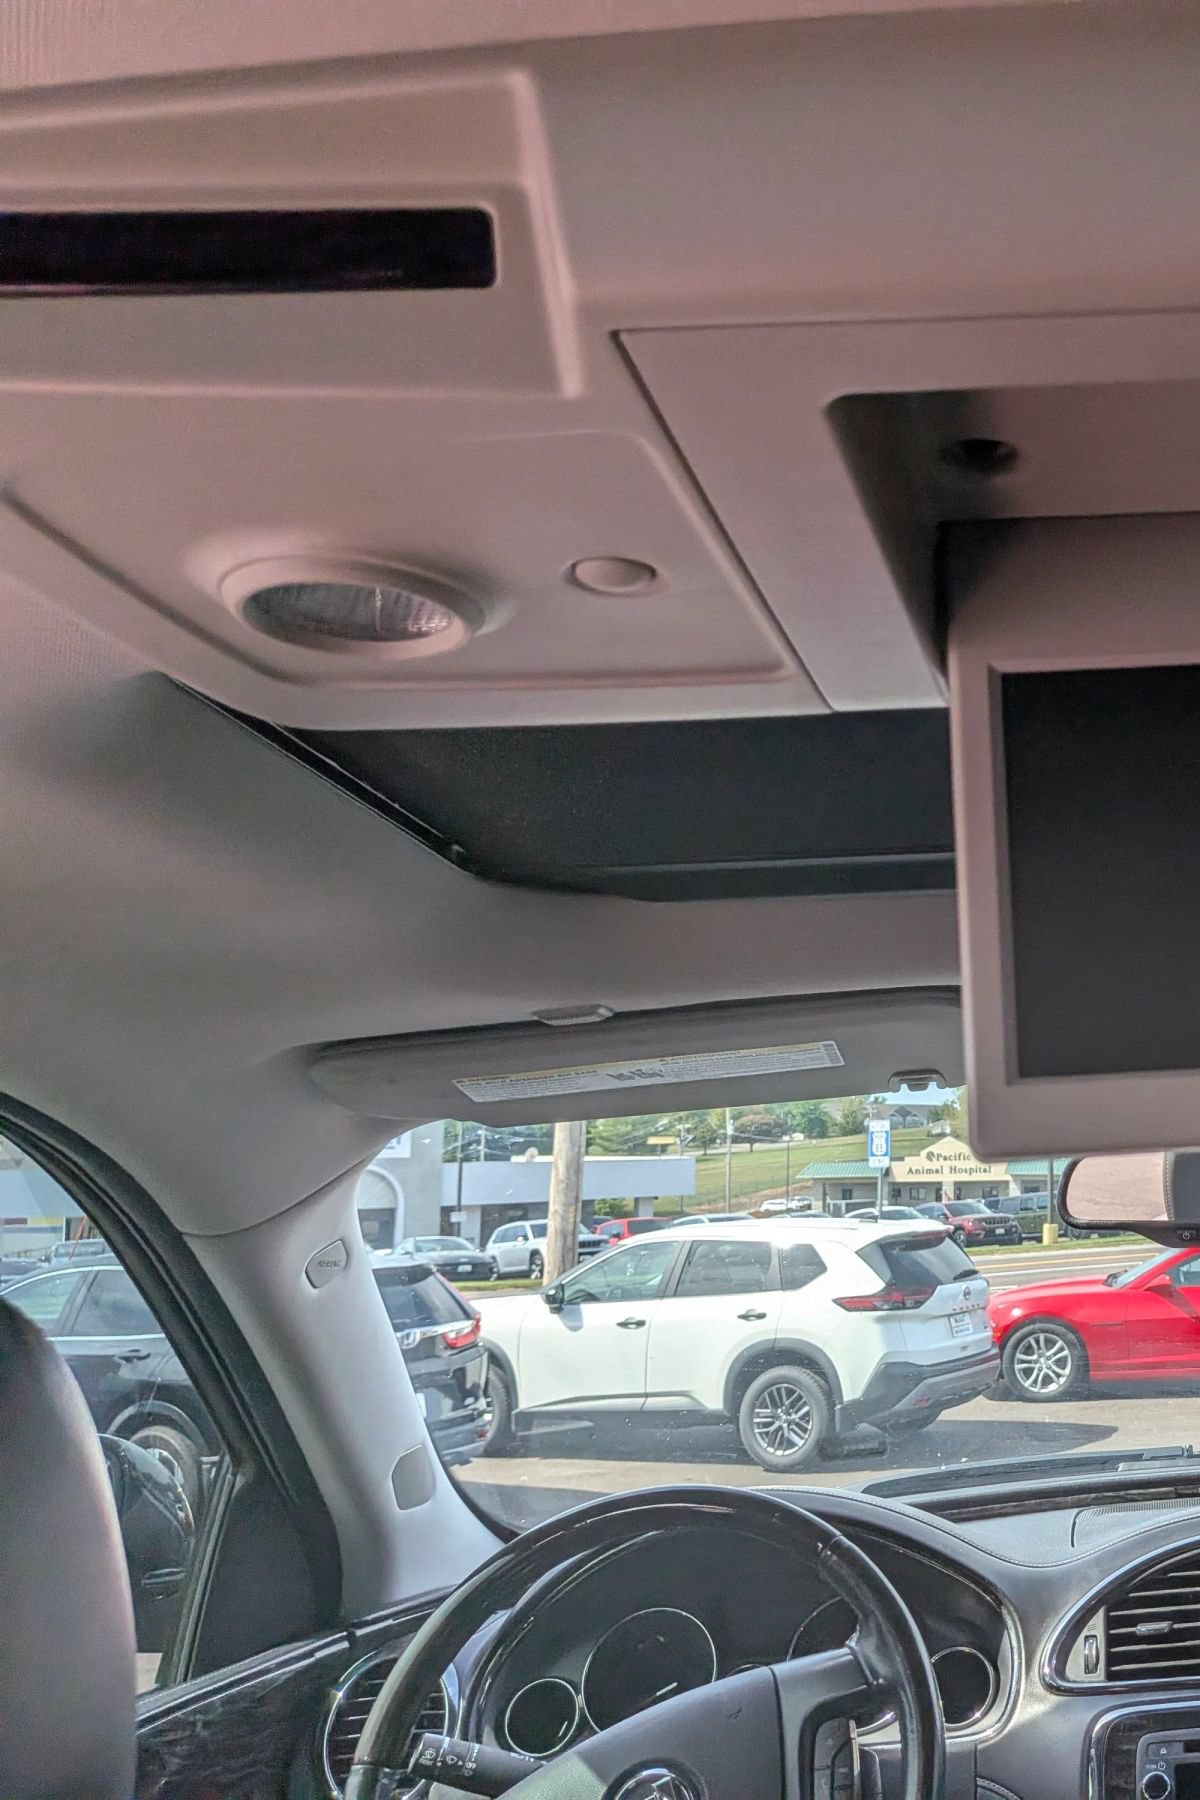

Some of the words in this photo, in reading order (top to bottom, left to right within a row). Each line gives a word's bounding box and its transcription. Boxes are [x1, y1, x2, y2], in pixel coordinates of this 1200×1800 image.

[936, 1151, 972, 1162] Pacific
[906, 1165, 944, 1176] Animal
[949, 1165, 992, 1176] Hospital
